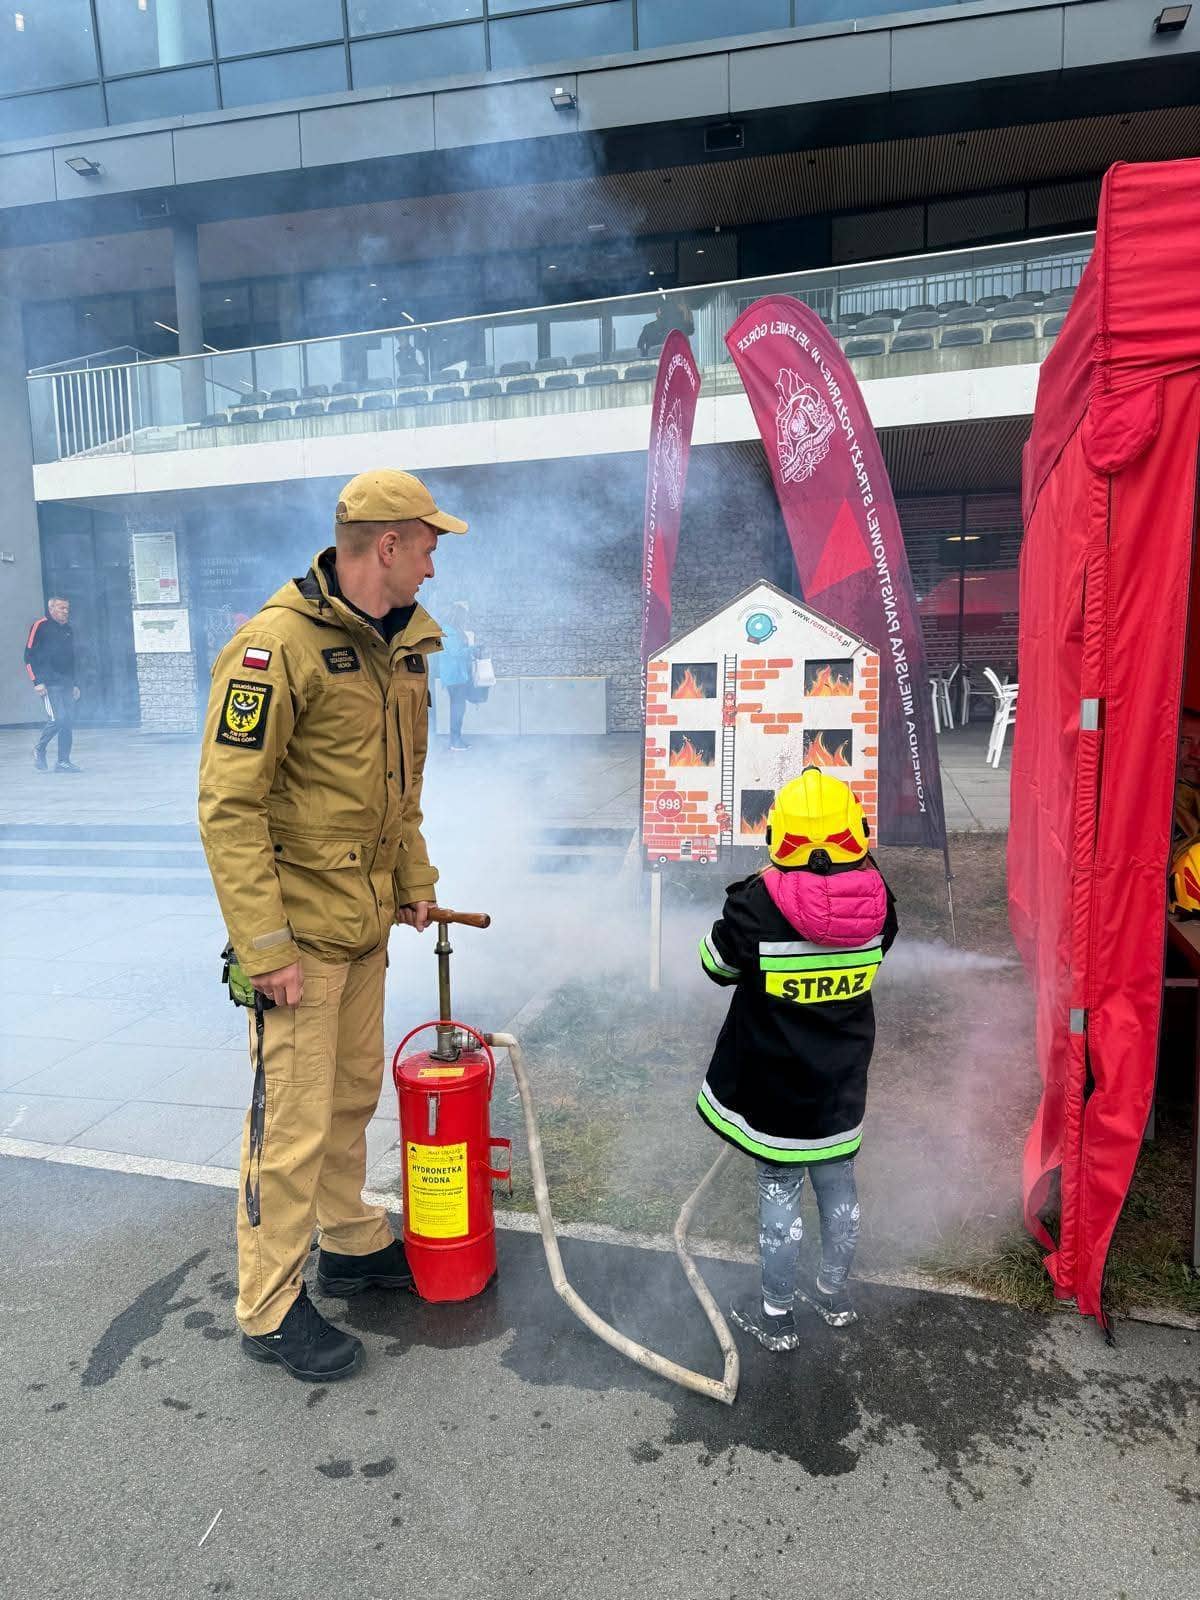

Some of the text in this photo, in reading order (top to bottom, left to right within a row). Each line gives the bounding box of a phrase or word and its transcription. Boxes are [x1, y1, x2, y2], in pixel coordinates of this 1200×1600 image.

[658, 798, 680, 810] 998
[412, 1164, 462, 1175] HYDRONETKA
[421, 1175, 451, 1184] WODNA
